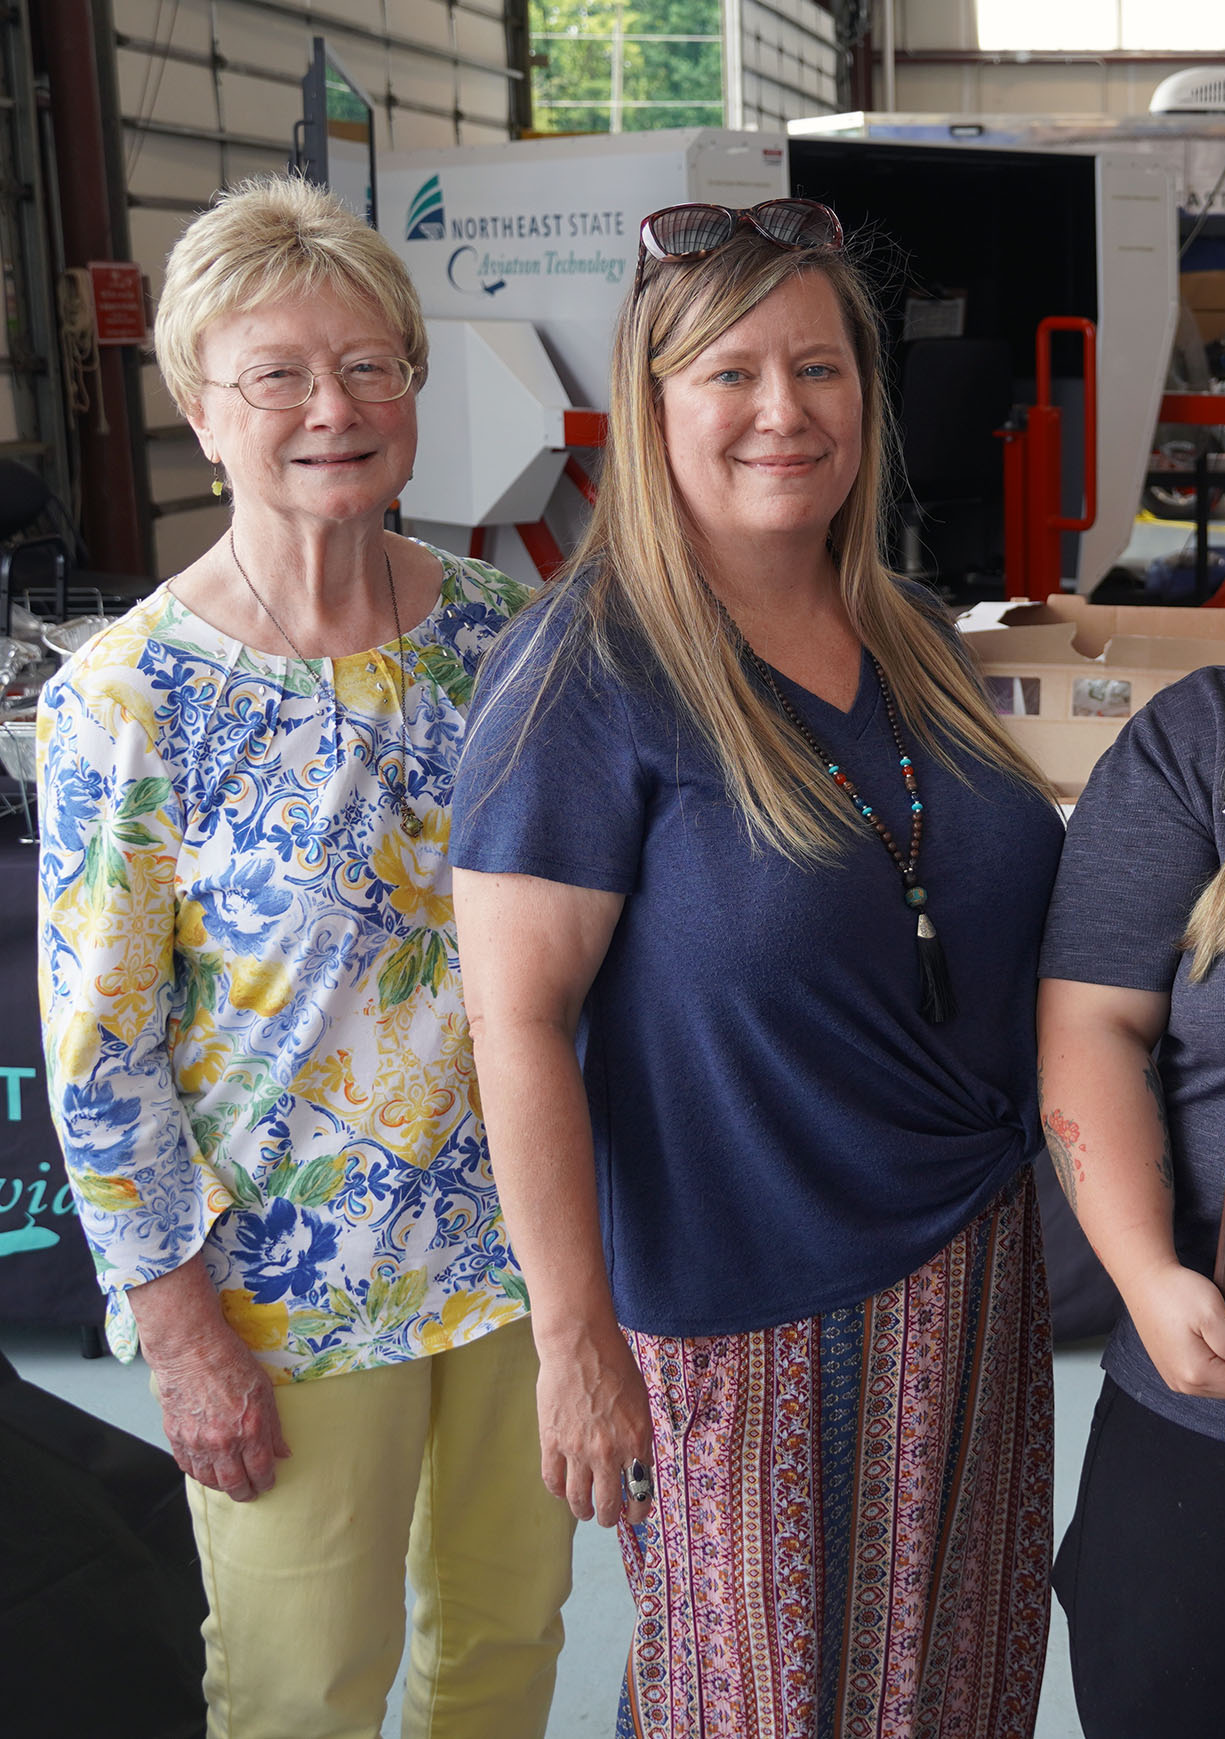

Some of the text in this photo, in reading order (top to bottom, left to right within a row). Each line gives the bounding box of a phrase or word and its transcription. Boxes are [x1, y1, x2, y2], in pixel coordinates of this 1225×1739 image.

[451, 211, 625, 240] NORTHEAST STATE
[477, 250, 626, 283] Aviation Technology
